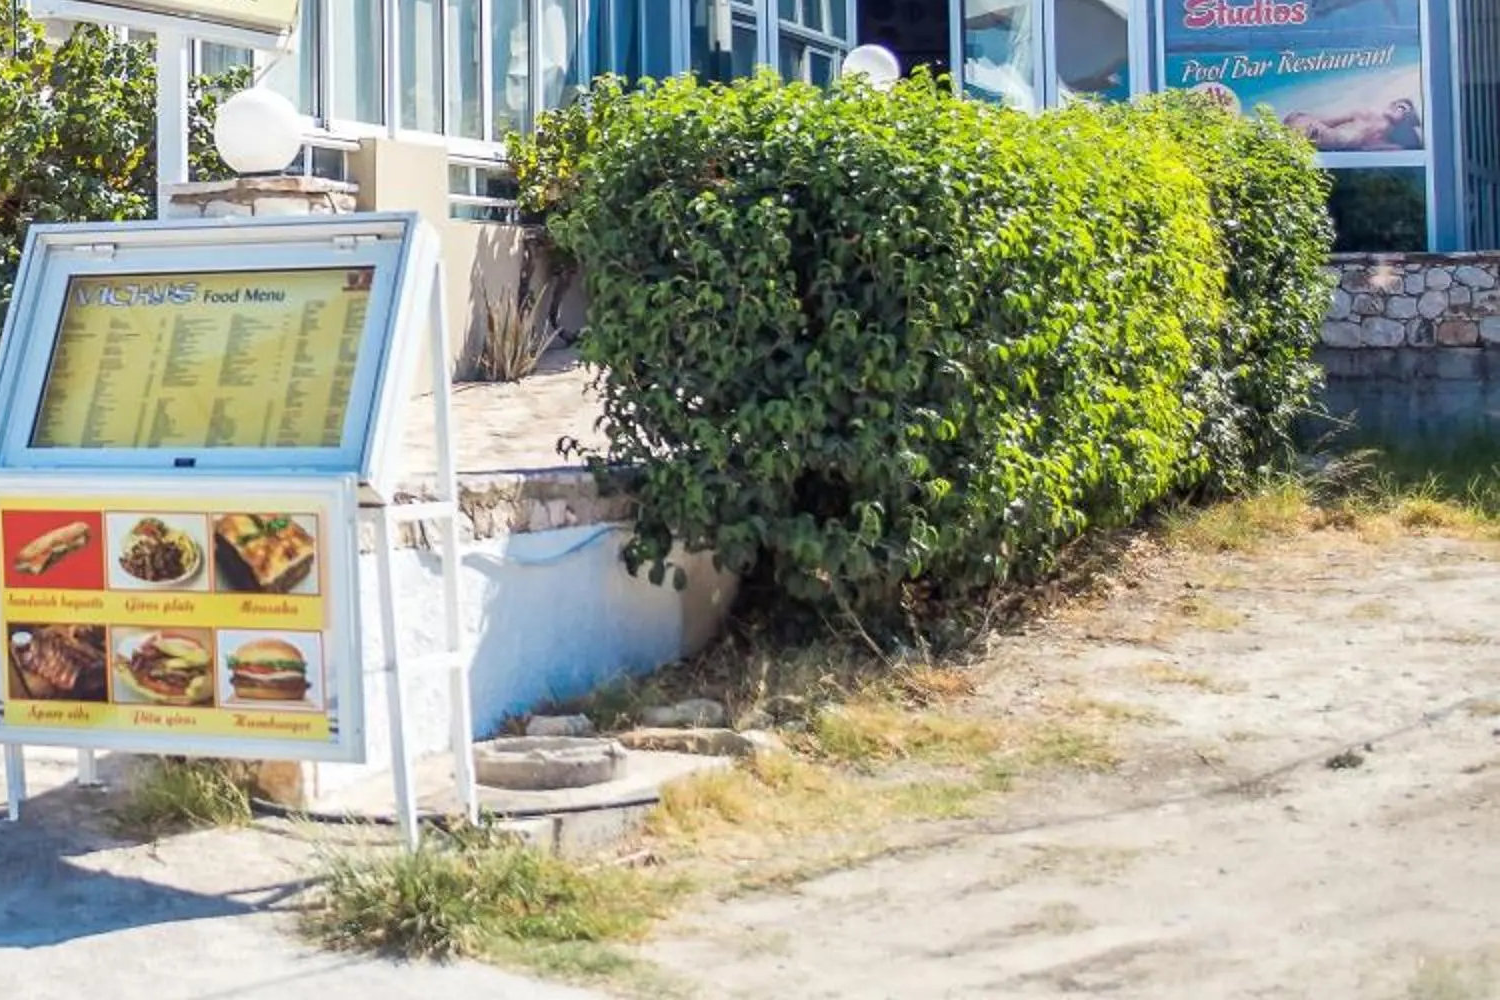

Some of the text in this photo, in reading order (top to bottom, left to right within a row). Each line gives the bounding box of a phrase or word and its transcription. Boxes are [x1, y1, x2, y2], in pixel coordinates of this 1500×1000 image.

[1181, 44, 1395, 83] Pool Bar Restaurant
[203, 288, 240, 304] Food
[244, 287, 285, 303] Menu
